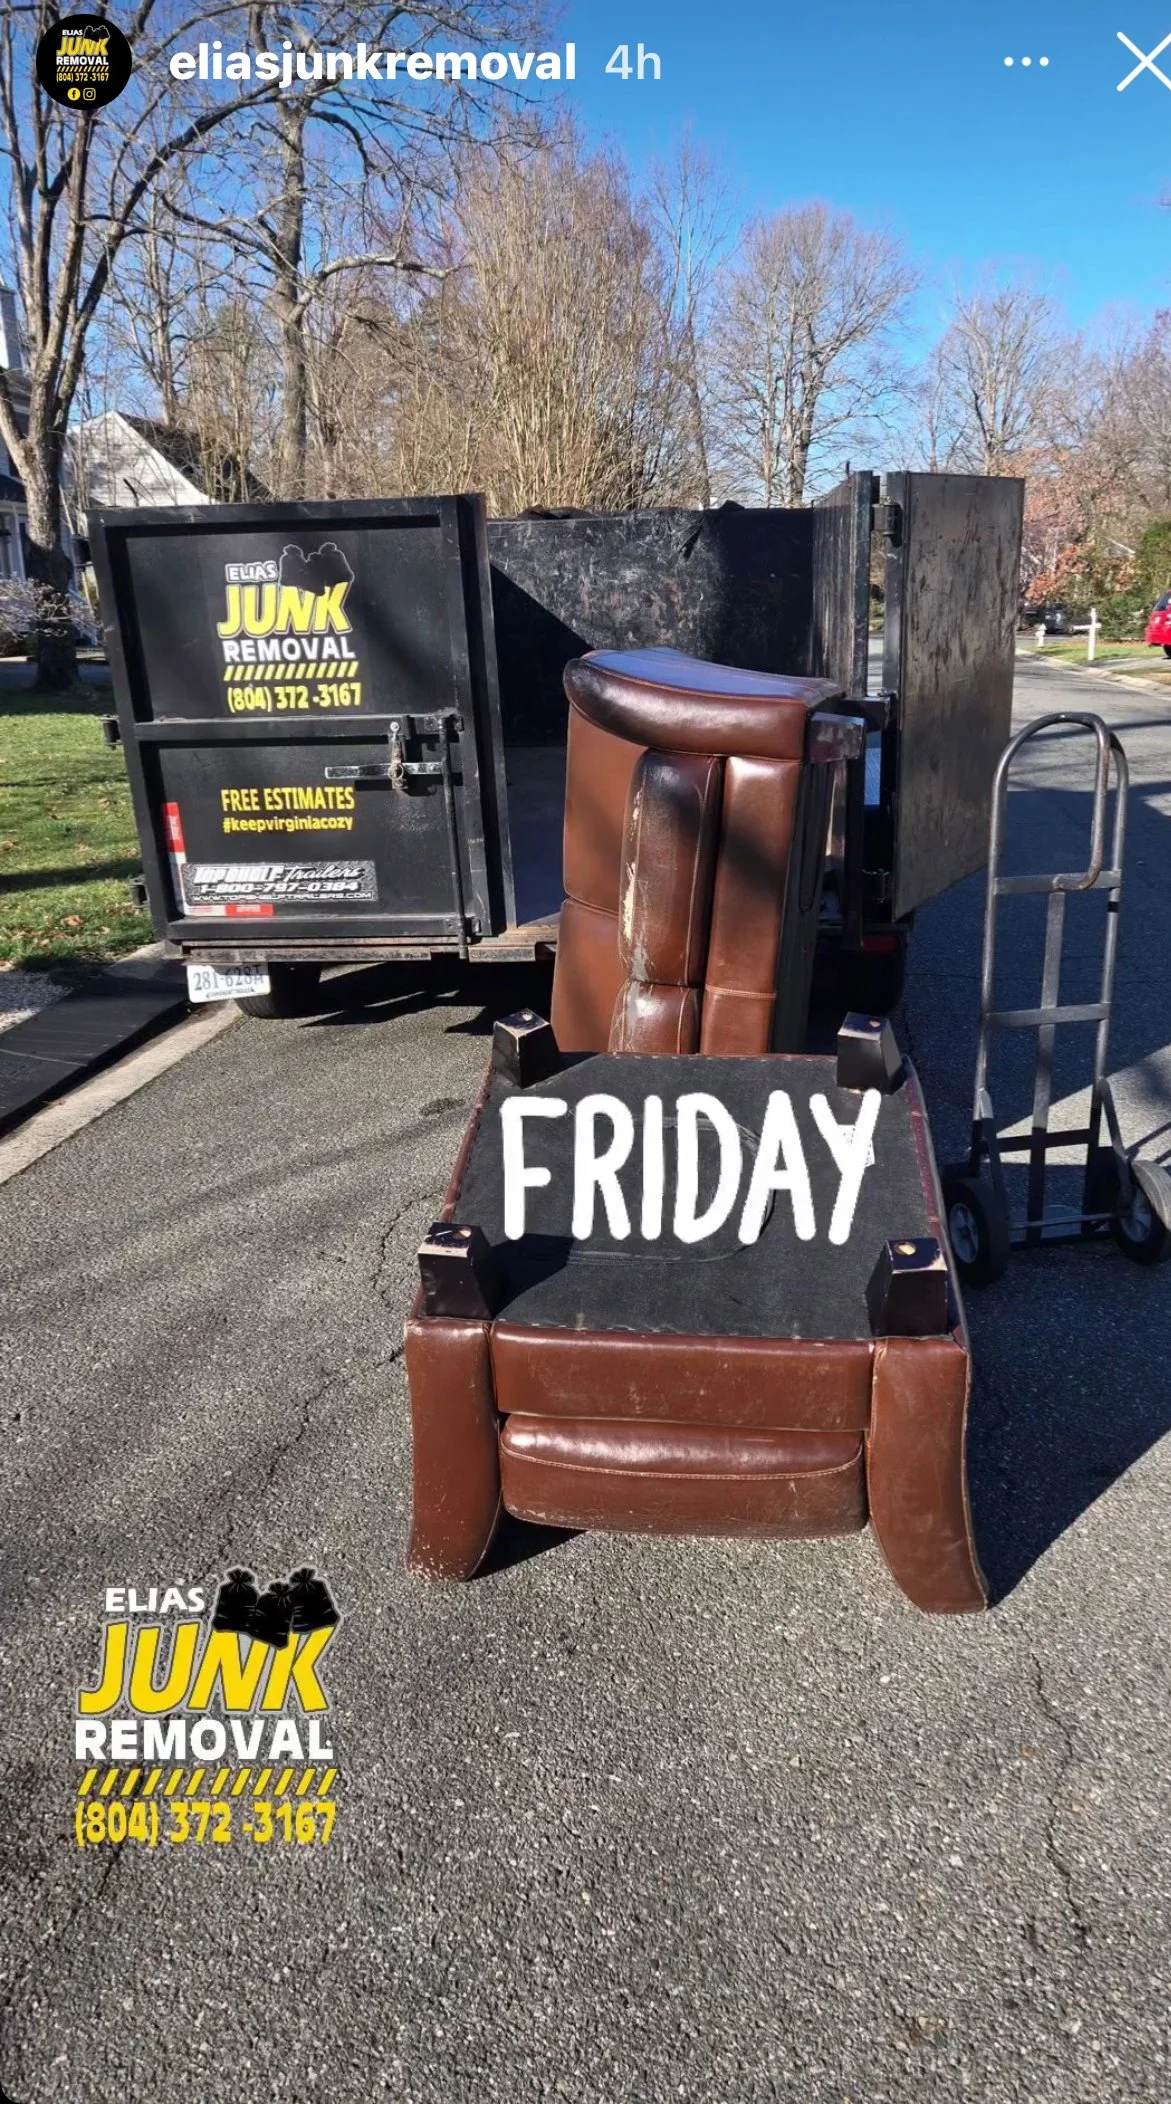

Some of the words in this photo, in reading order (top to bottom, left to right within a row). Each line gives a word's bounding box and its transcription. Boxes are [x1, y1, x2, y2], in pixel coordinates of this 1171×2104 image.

[228, 564, 278, 581] ELIAS
[218, 582, 351, 636] JUNK
[222, 636, 356, 662] REMOVAL
[228, 686, 272, 713] (804)
[274, 685, 309, 709] 372
[221, 789, 261, 811] FREE
[264, 786, 355, 811] ESTIMATES
[223, 816, 353, 833] #keepvirginiacozy
